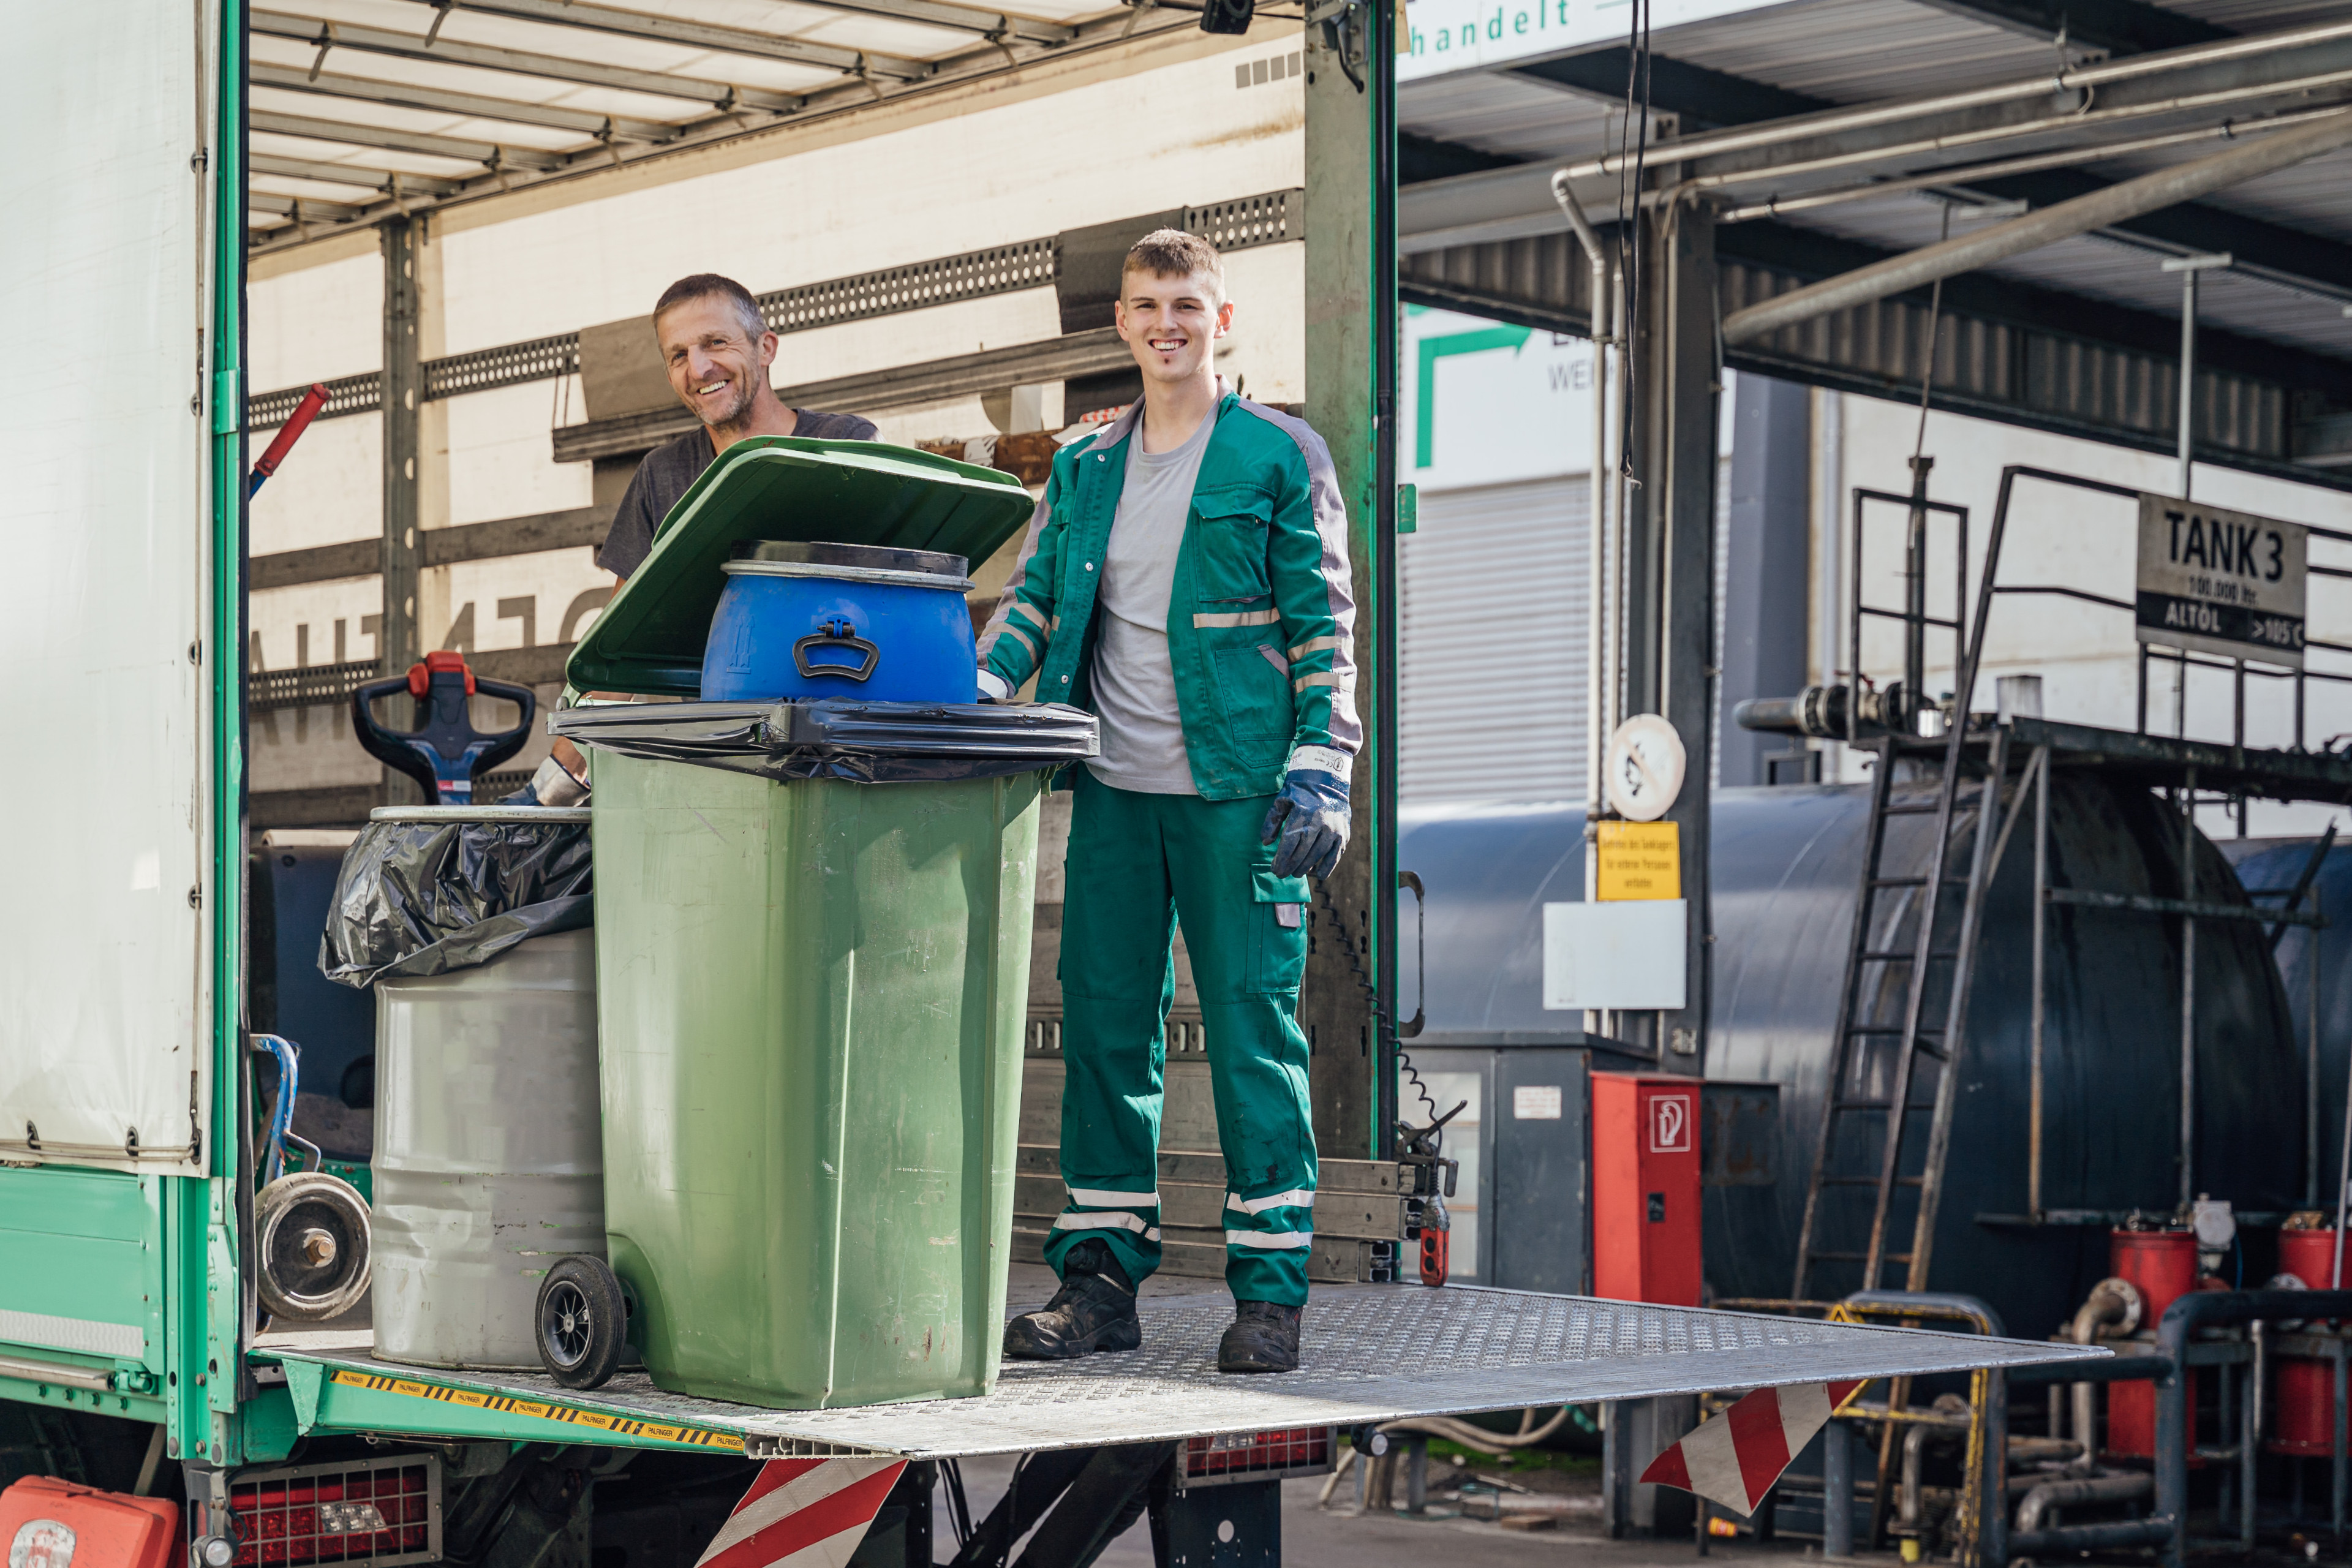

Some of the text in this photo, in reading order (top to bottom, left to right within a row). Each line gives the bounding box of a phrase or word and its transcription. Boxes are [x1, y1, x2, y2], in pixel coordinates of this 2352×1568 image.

[1410, 0, 1567, 56] handelt
[2164, 510, 2284, 584] TANK 3
[2165, 601, 2221, 633] ALTÖL
[399, 1384, 420, 1393] PALFINGER
[458, 1393, 480, 1404] PALFINGER
[519, 1404, 541, 1414] PALFINGER
[582, 1414, 606, 1426] PALFINGER
[648, 1427, 673, 1438] PALFINGER
[717, 1436, 742, 1447] PALFINGER
